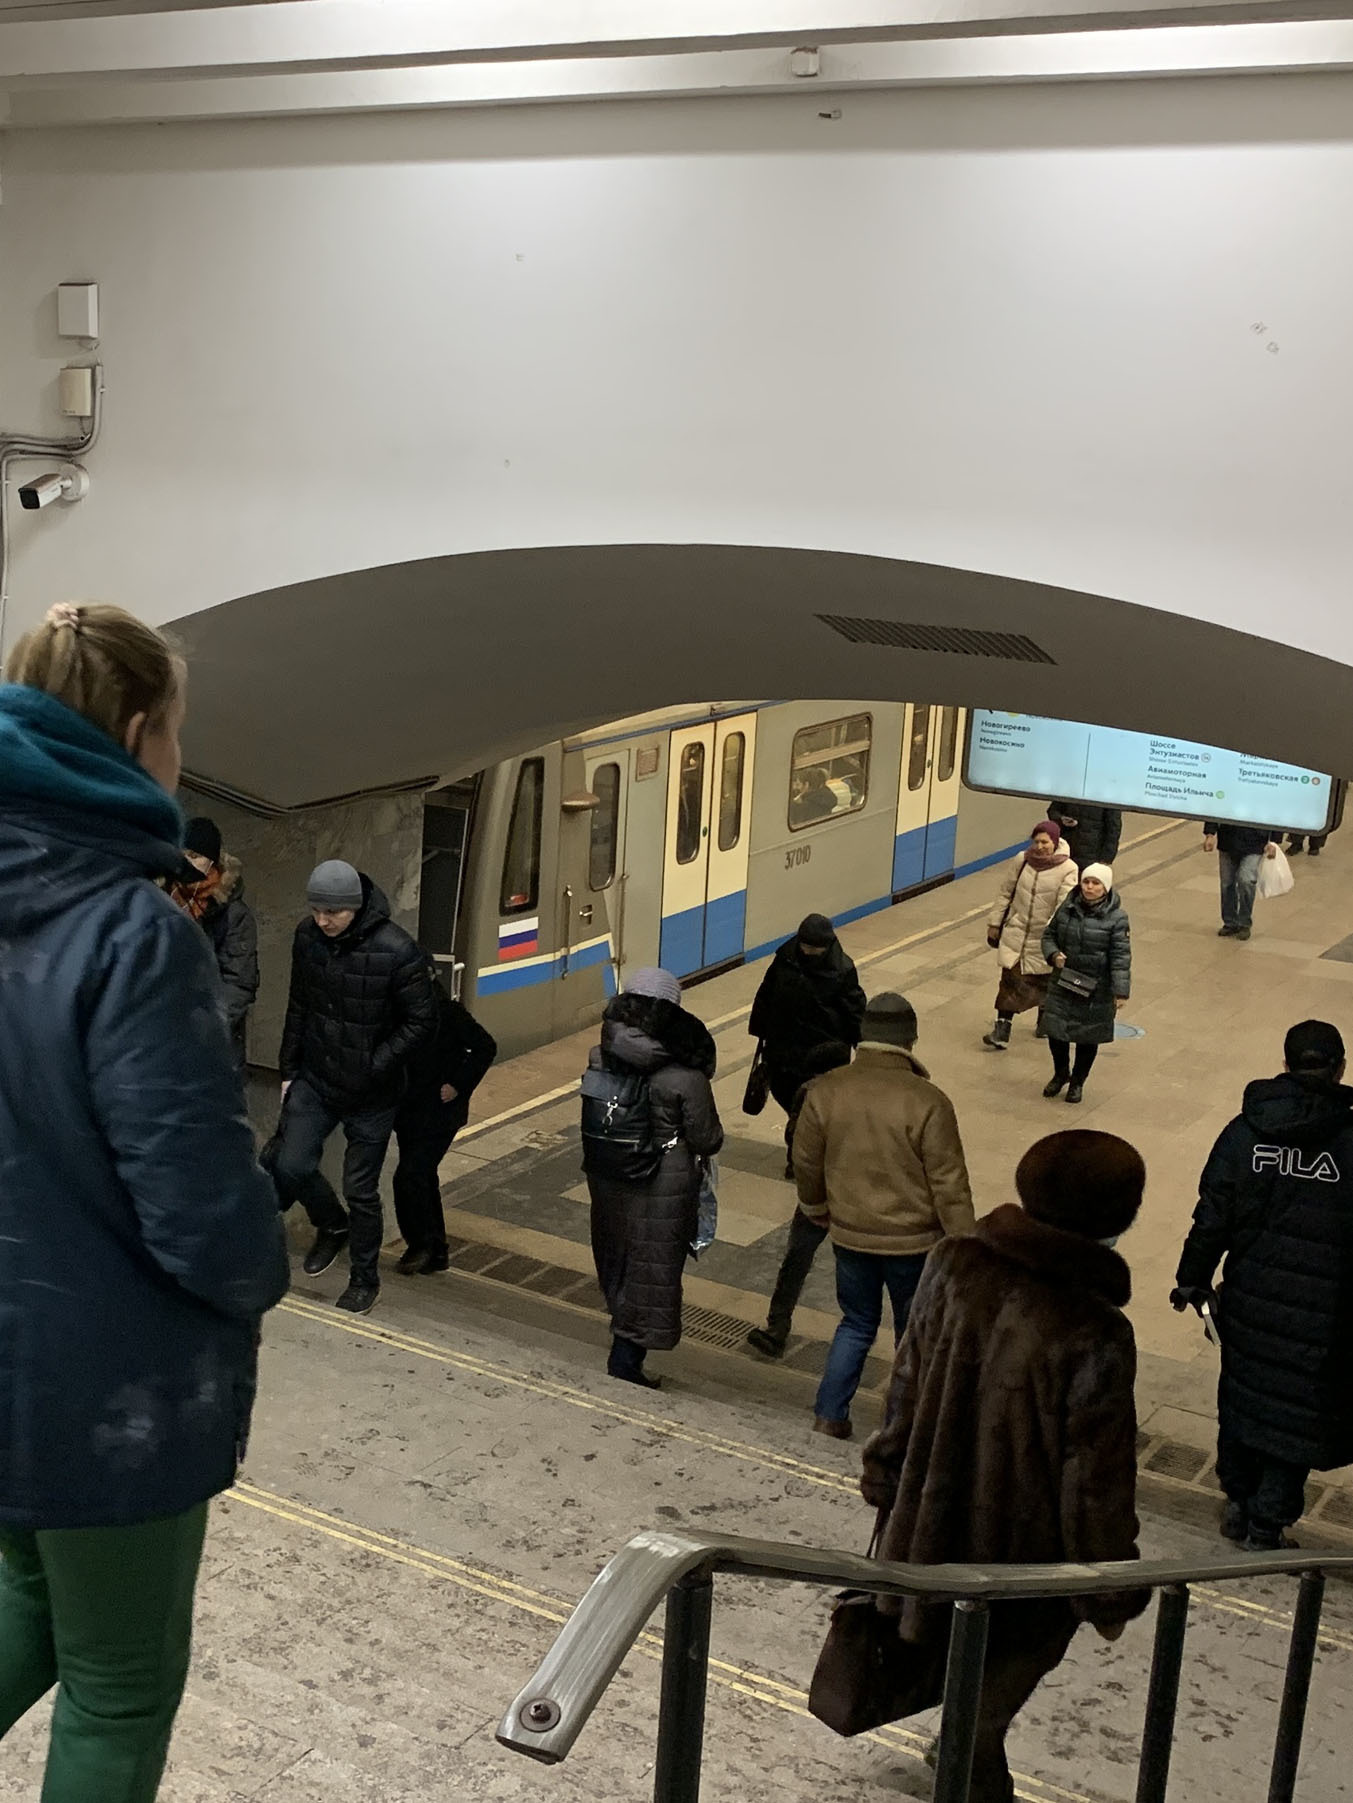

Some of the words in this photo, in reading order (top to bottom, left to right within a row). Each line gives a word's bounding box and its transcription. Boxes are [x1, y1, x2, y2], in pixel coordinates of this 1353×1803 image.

[1150, 740, 1176, 749] Шоссе
[1147, 765, 1206, 778] Авиамоторная
[1145, 782, 1182, 793] Площадь
[1253, 1144, 1340, 1182] FILA
